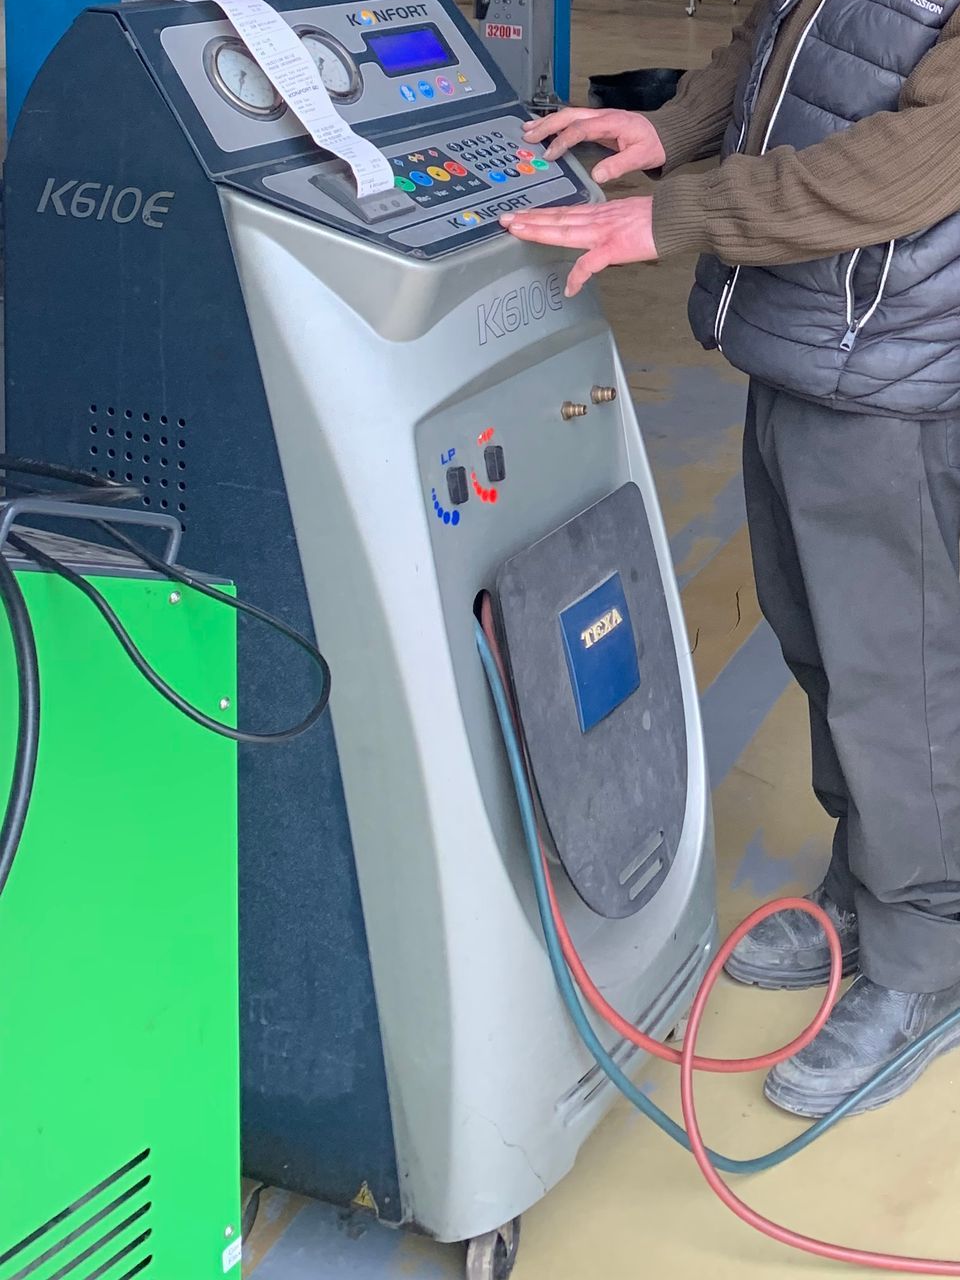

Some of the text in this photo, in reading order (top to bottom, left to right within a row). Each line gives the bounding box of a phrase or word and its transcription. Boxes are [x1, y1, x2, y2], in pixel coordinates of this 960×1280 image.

[488, 24, 511, 38] 3200
[441, 448, 455, 465] LP
[580, 608, 623, 649] TEXA
